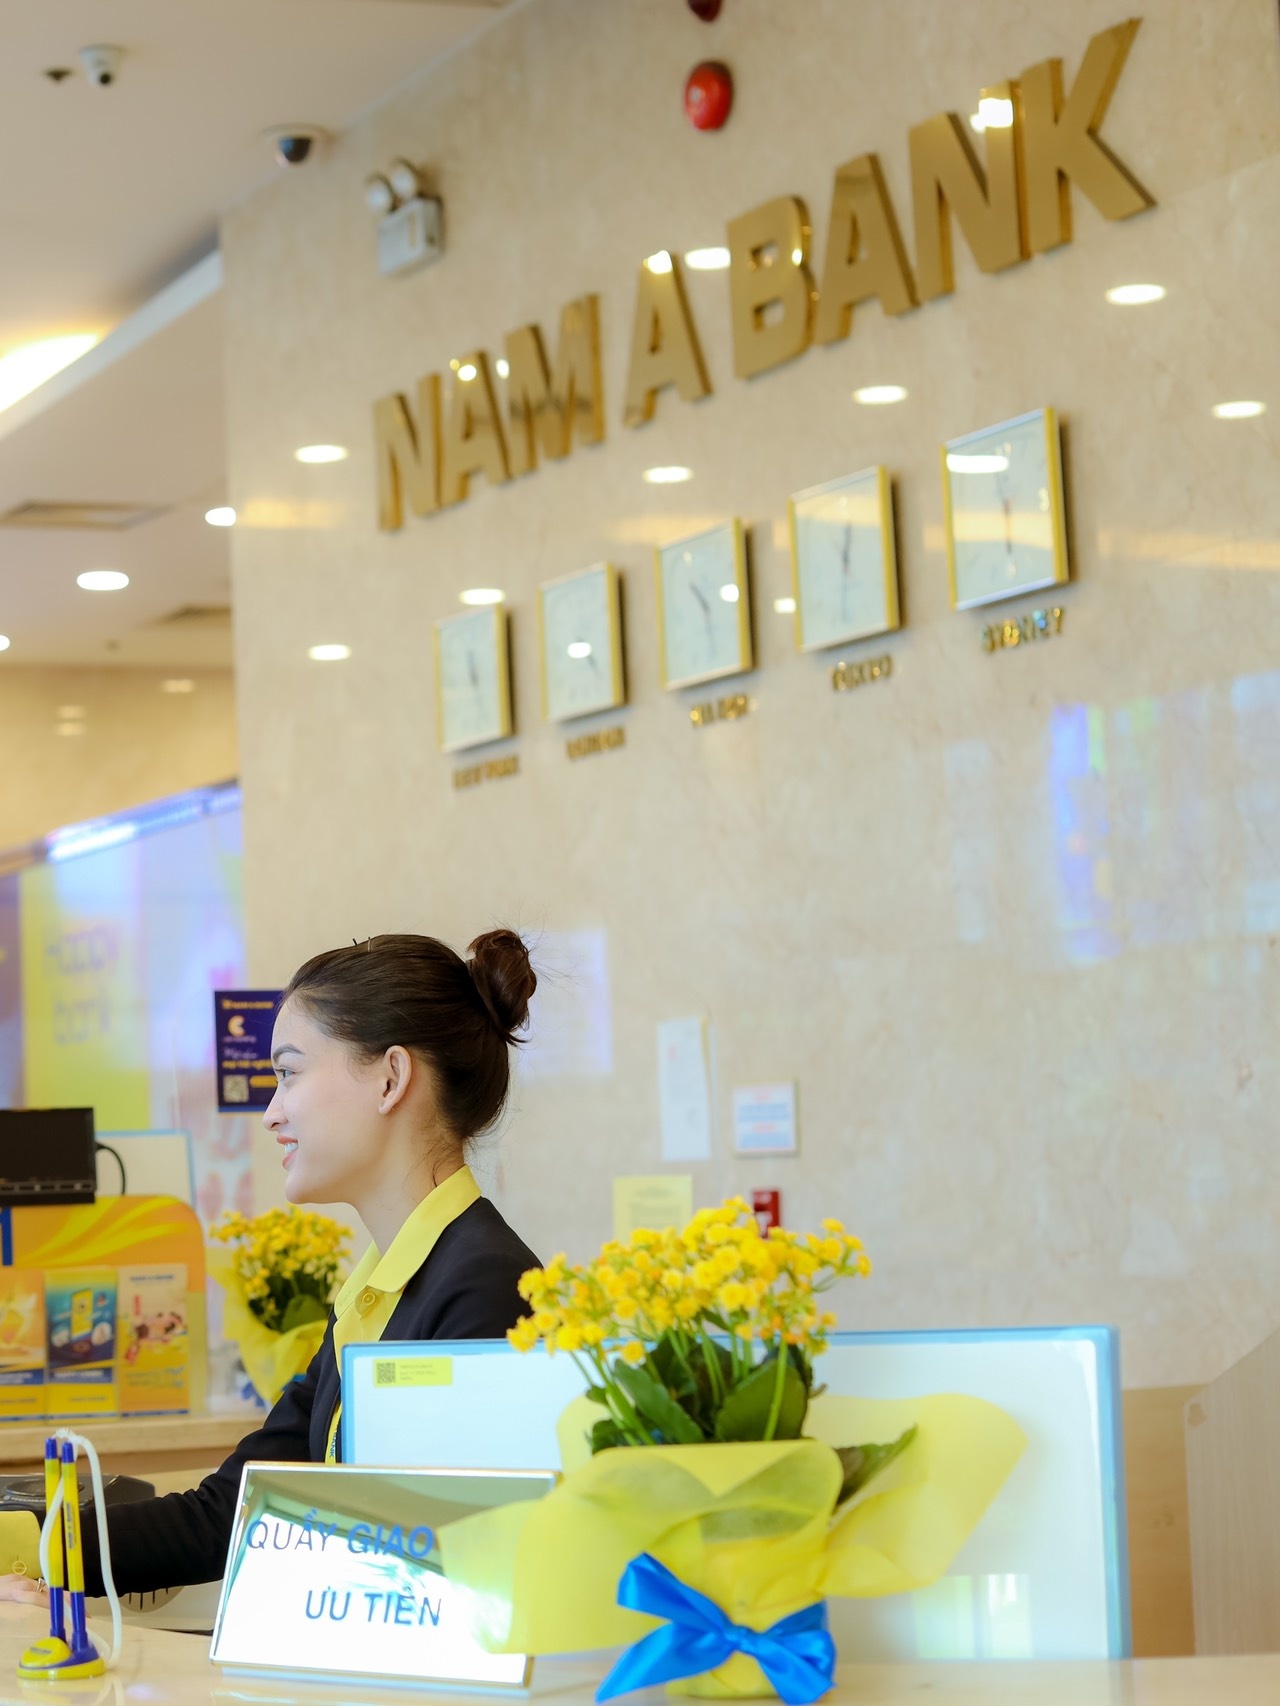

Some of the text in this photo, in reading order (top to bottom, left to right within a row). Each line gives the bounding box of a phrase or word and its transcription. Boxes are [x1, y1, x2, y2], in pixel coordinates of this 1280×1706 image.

[373, 18, 1157, 531] NAM A BANK
[347, 1522, 435, 1559] GIAO
